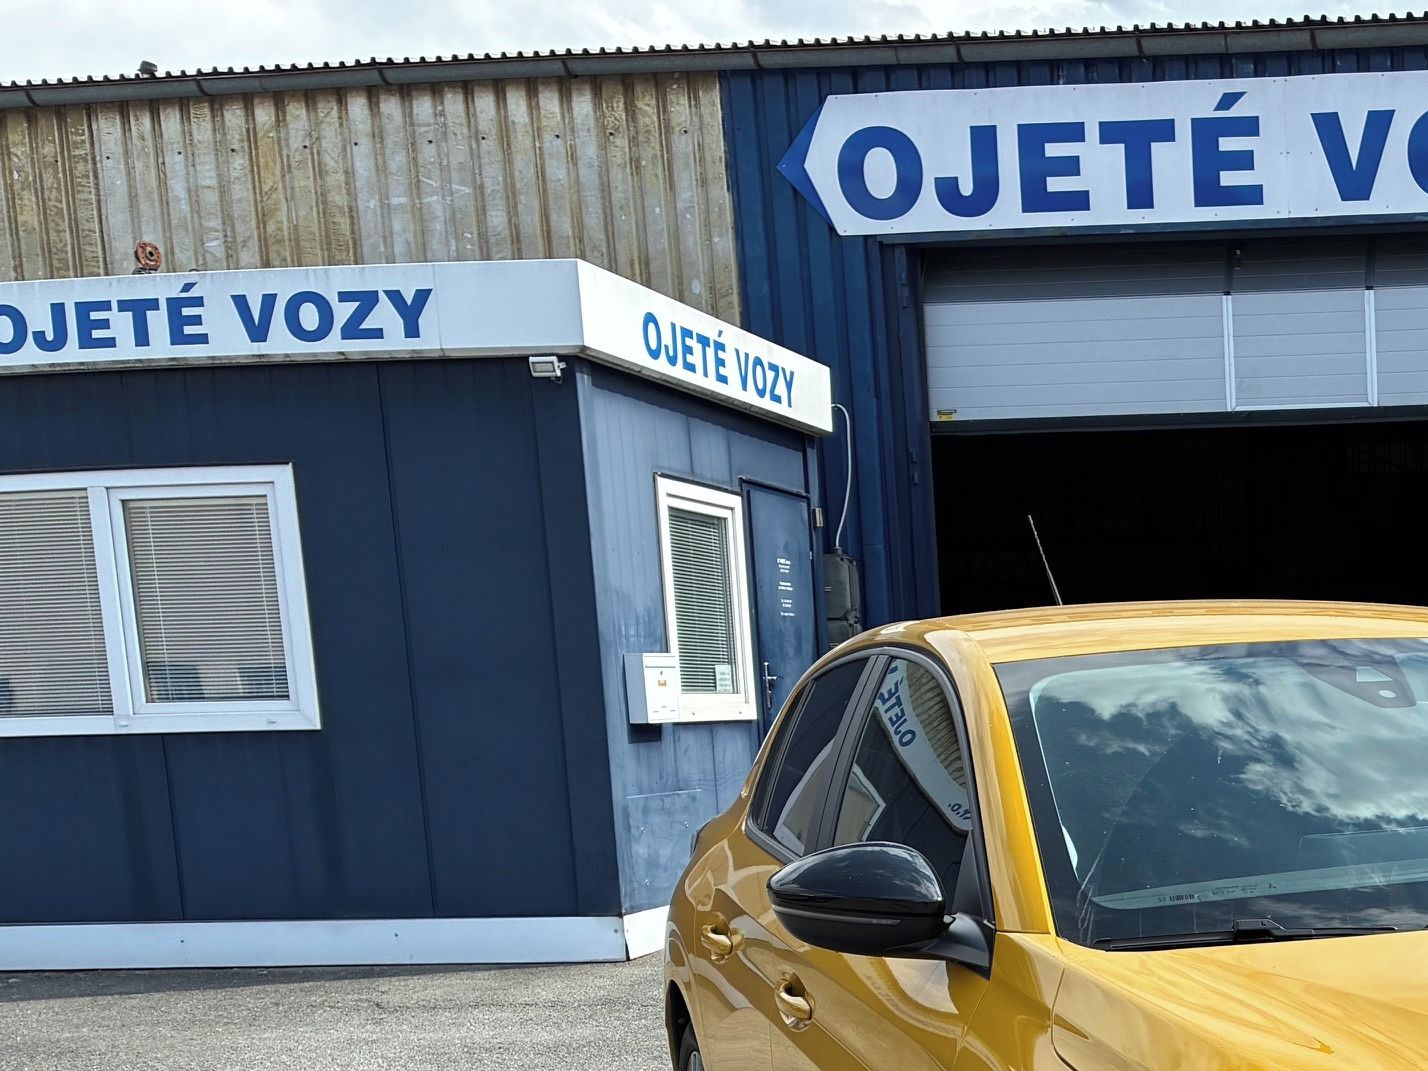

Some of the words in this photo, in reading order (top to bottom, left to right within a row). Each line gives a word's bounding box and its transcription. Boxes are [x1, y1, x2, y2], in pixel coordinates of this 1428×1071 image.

[837, 91, 1264, 220] OJETÉ
[230, 288, 433, 343] VOZY
[643, 311, 728, 386] OJETÉ
[734, 347, 795, 408] VOZY
